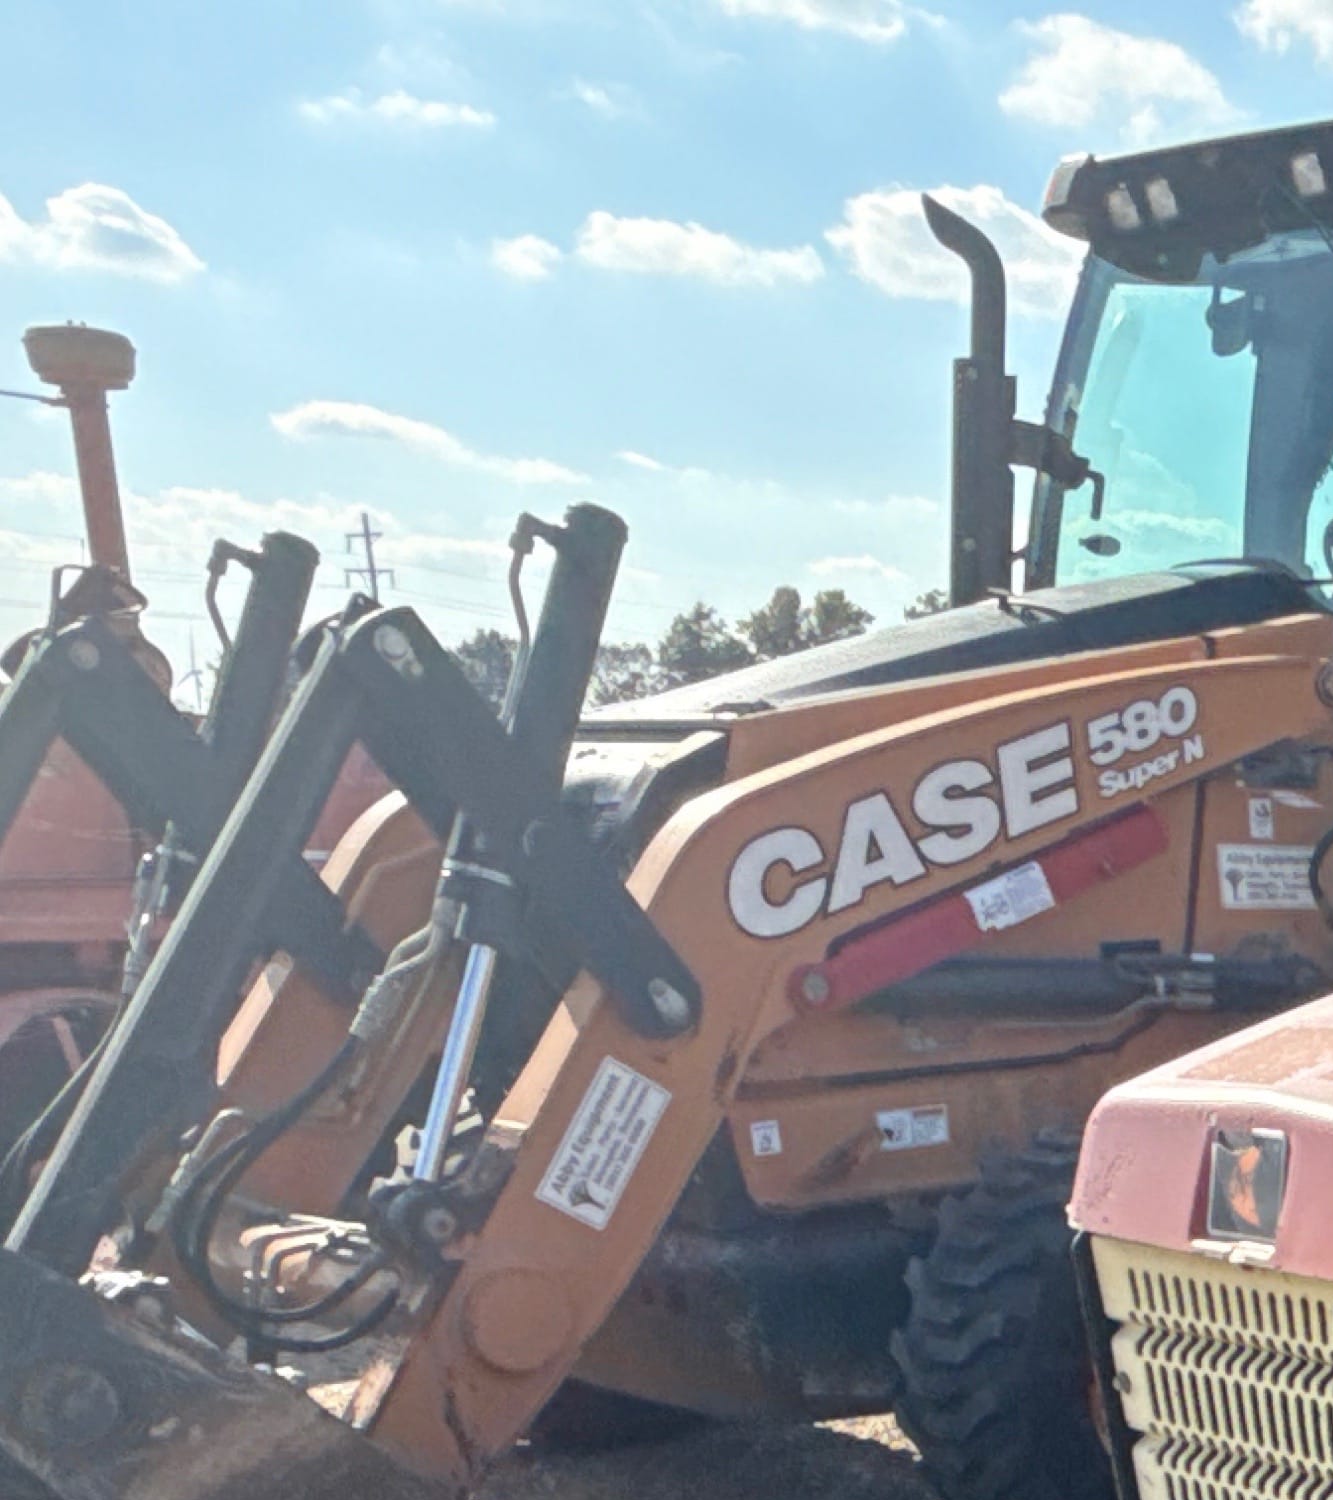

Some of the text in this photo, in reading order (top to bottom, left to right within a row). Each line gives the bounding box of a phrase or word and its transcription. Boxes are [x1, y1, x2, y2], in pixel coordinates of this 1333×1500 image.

[1087, 686, 1197, 766] 580
[1098, 733, 1204, 797] Super N
[728, 721, 1077, 938] CASE
[551, 1154, 580, 1195] Abby
[571, 1073, 620, 1154] Equipment
